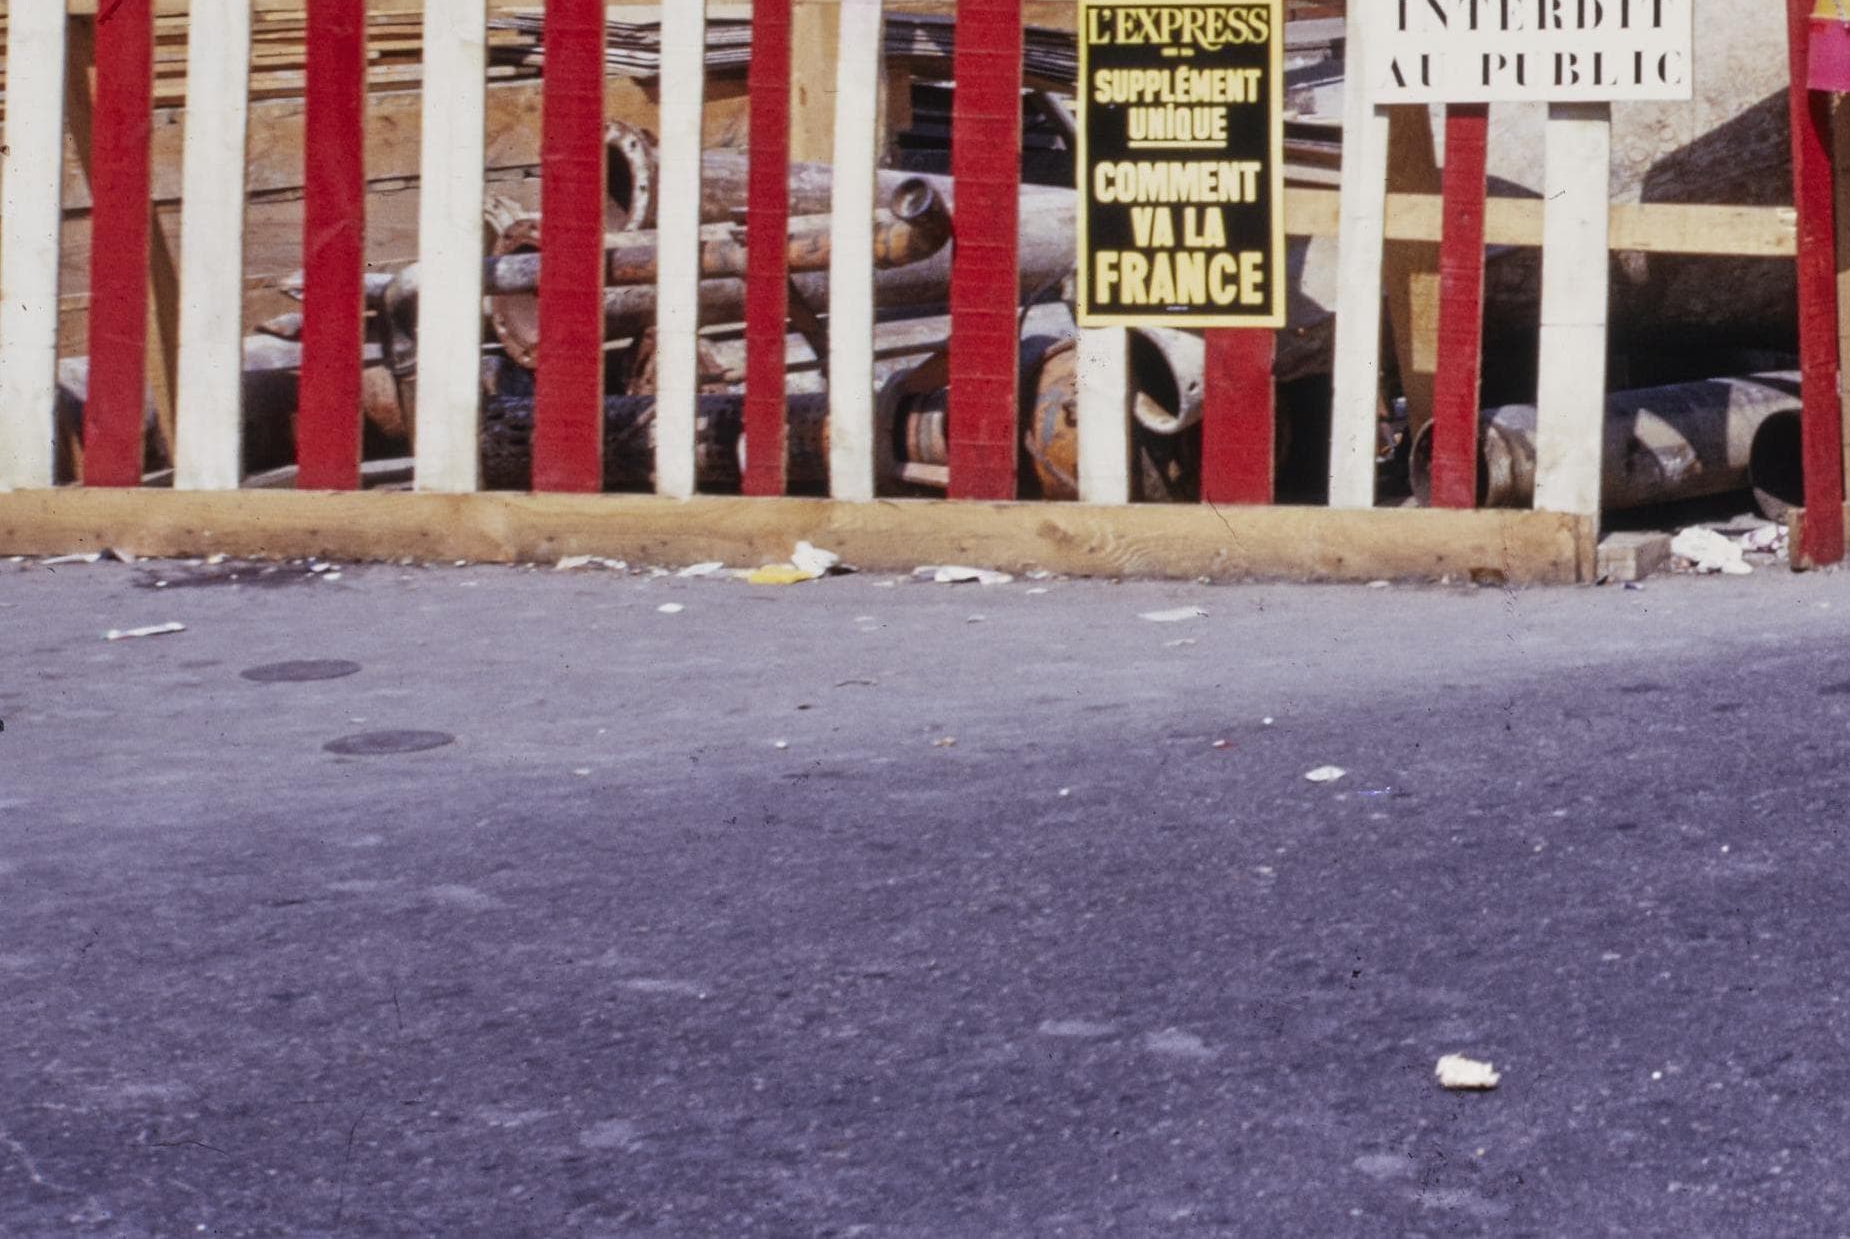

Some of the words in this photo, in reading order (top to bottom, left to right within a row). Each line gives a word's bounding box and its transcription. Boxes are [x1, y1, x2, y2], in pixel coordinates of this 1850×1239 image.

[1087, 6, 1269, 46] L'EXPRESS
[1093, 64, 1262, 104] SUPPLÉMENT
[1381, 52, 1432, 90] AU
[1479, 49, 1684, 88] PUBLIC
[1127, 105, 1227, 141] UNIQUE
[1093, 162, 1261, 205] COMMENT
[1131, 207, 1176, 249] VA
[1183, 207, 1227, 249] LA
[1094, 251, 1265, 305] FRANCE
